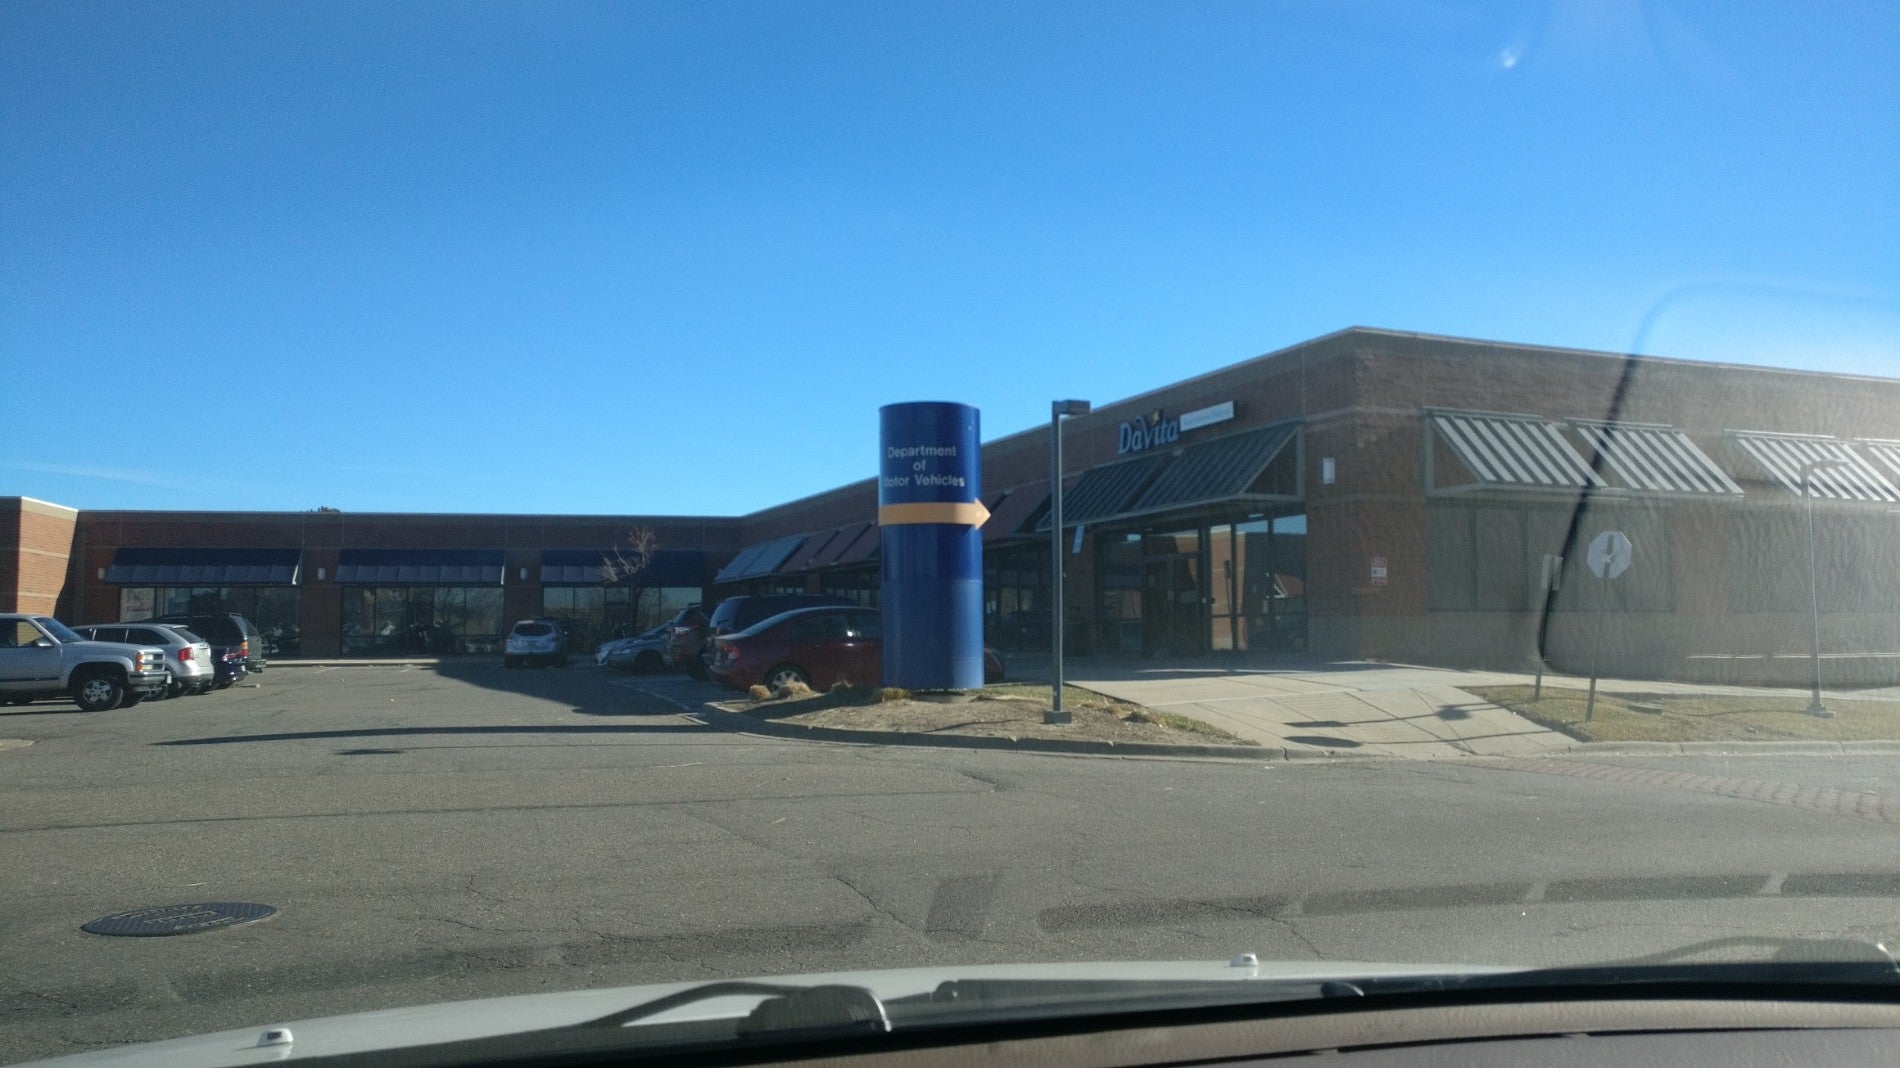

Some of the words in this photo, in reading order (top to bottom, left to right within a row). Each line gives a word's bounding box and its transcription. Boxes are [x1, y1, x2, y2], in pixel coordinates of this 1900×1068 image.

[1118, 415, 1180, 455] DaVita
[887, 445, 957, 458] Department
[912, 459, 926, 471] of
[914, 474, 966, 487] Vehicles
